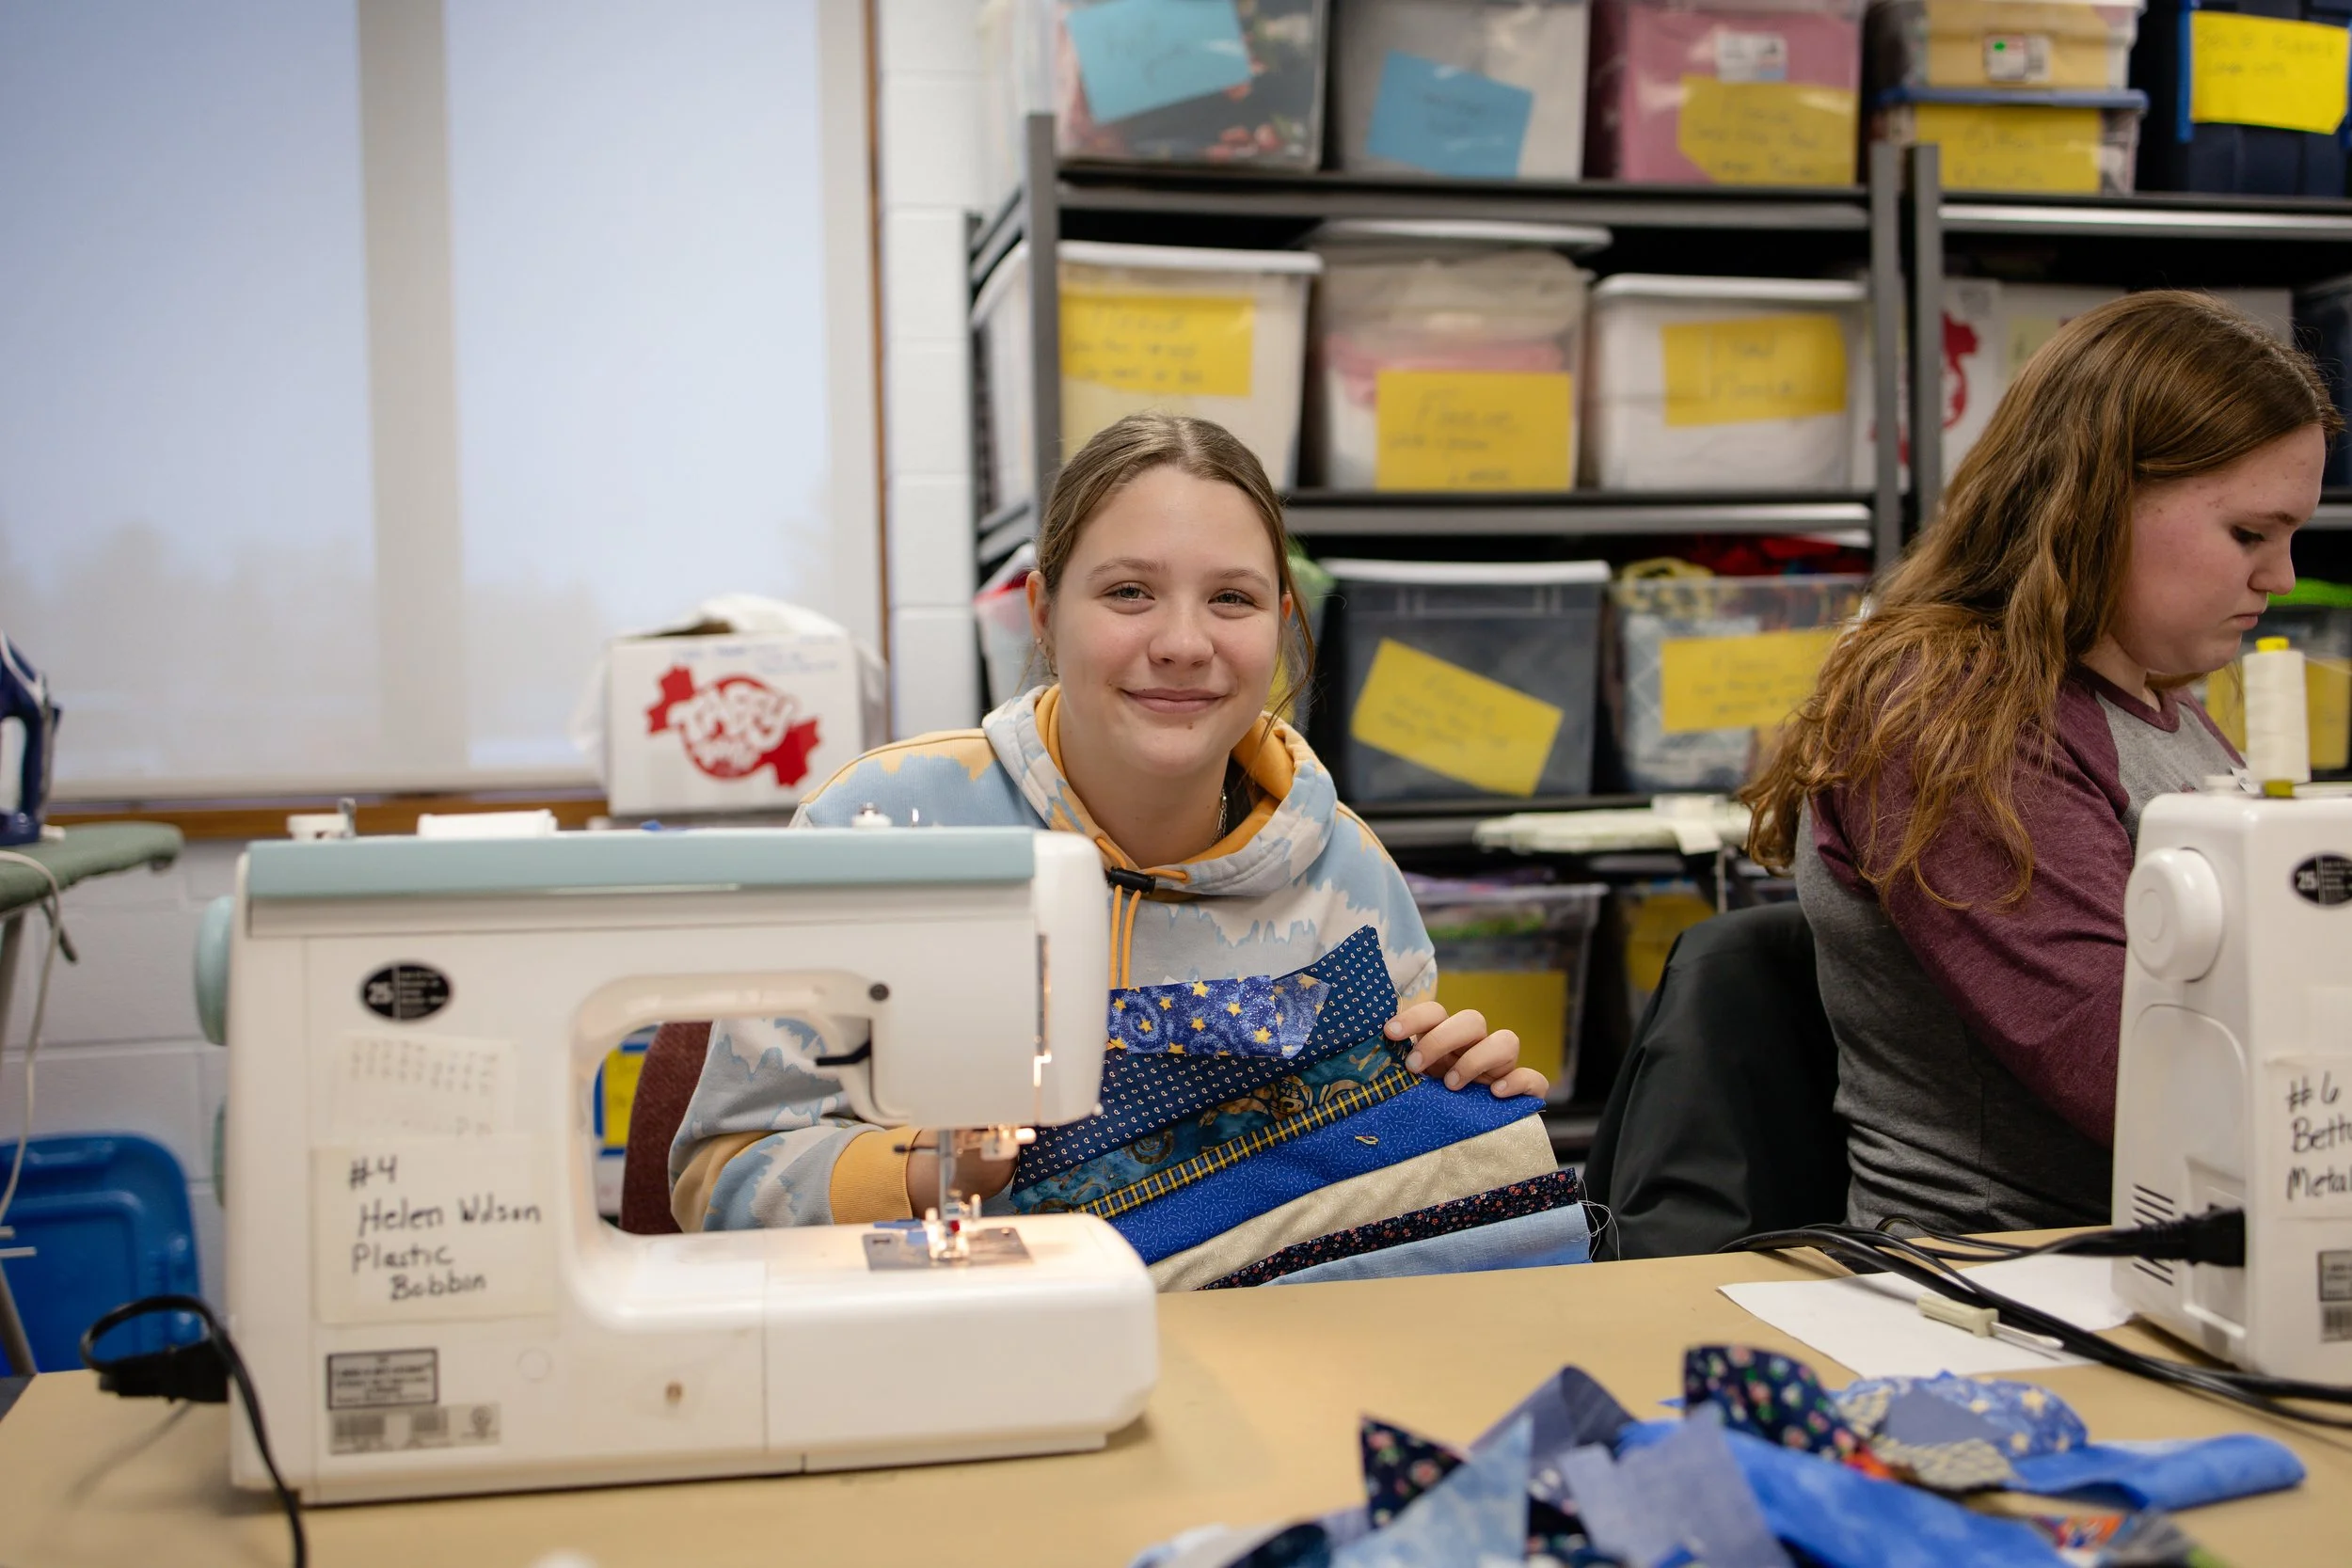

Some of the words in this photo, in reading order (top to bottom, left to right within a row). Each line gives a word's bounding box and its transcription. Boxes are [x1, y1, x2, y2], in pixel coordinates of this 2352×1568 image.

[2296, 870, 2318, 891] 25
[367, 981, 394, 1006] 25
[2285, 1069, 2341, 1114] #6
[349, 1153, 398, 1191] #4
[358, 1196, 444, 1238] Helen
[351, 1241, 455, 1275] Plastic
[389, 1269, 487, 1302] Bobbin
